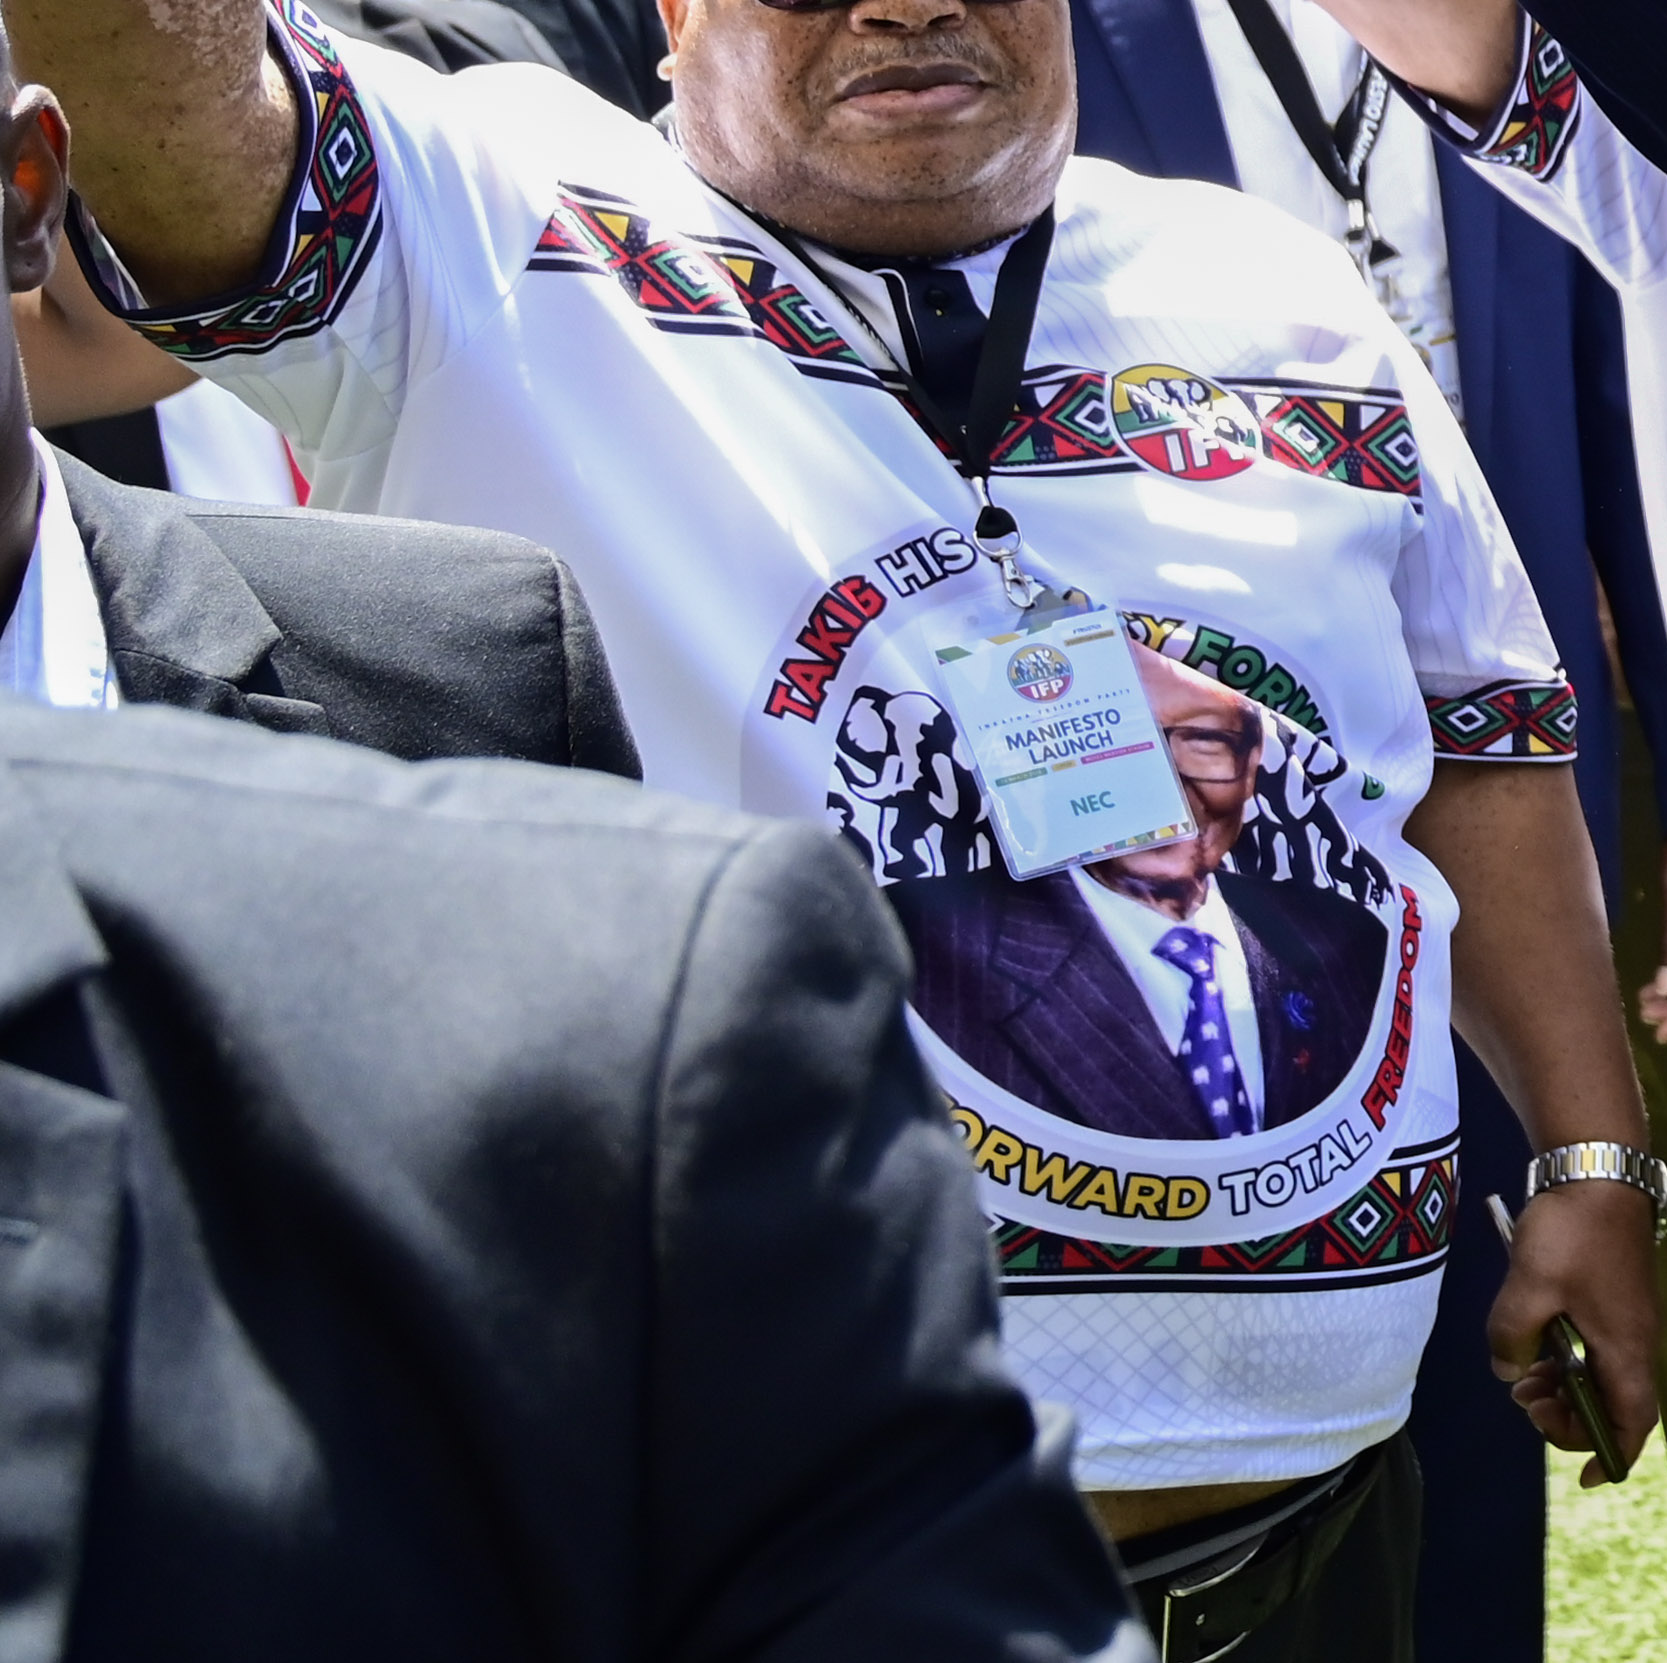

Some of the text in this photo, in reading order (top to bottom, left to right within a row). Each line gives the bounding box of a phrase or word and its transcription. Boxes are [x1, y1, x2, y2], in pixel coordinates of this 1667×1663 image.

[874, 527, 978, 598] HIS
[1030, 679, 1065, 700] IFP
[1005, 708, 1122, 752] MANIFESTO
[1028, 729, 1115, 765] LAUNCH
[1070, 790, 1116, 817] NEC
[944, 882, 1422, 1221] ORWARD TOTAL FREEDOM
